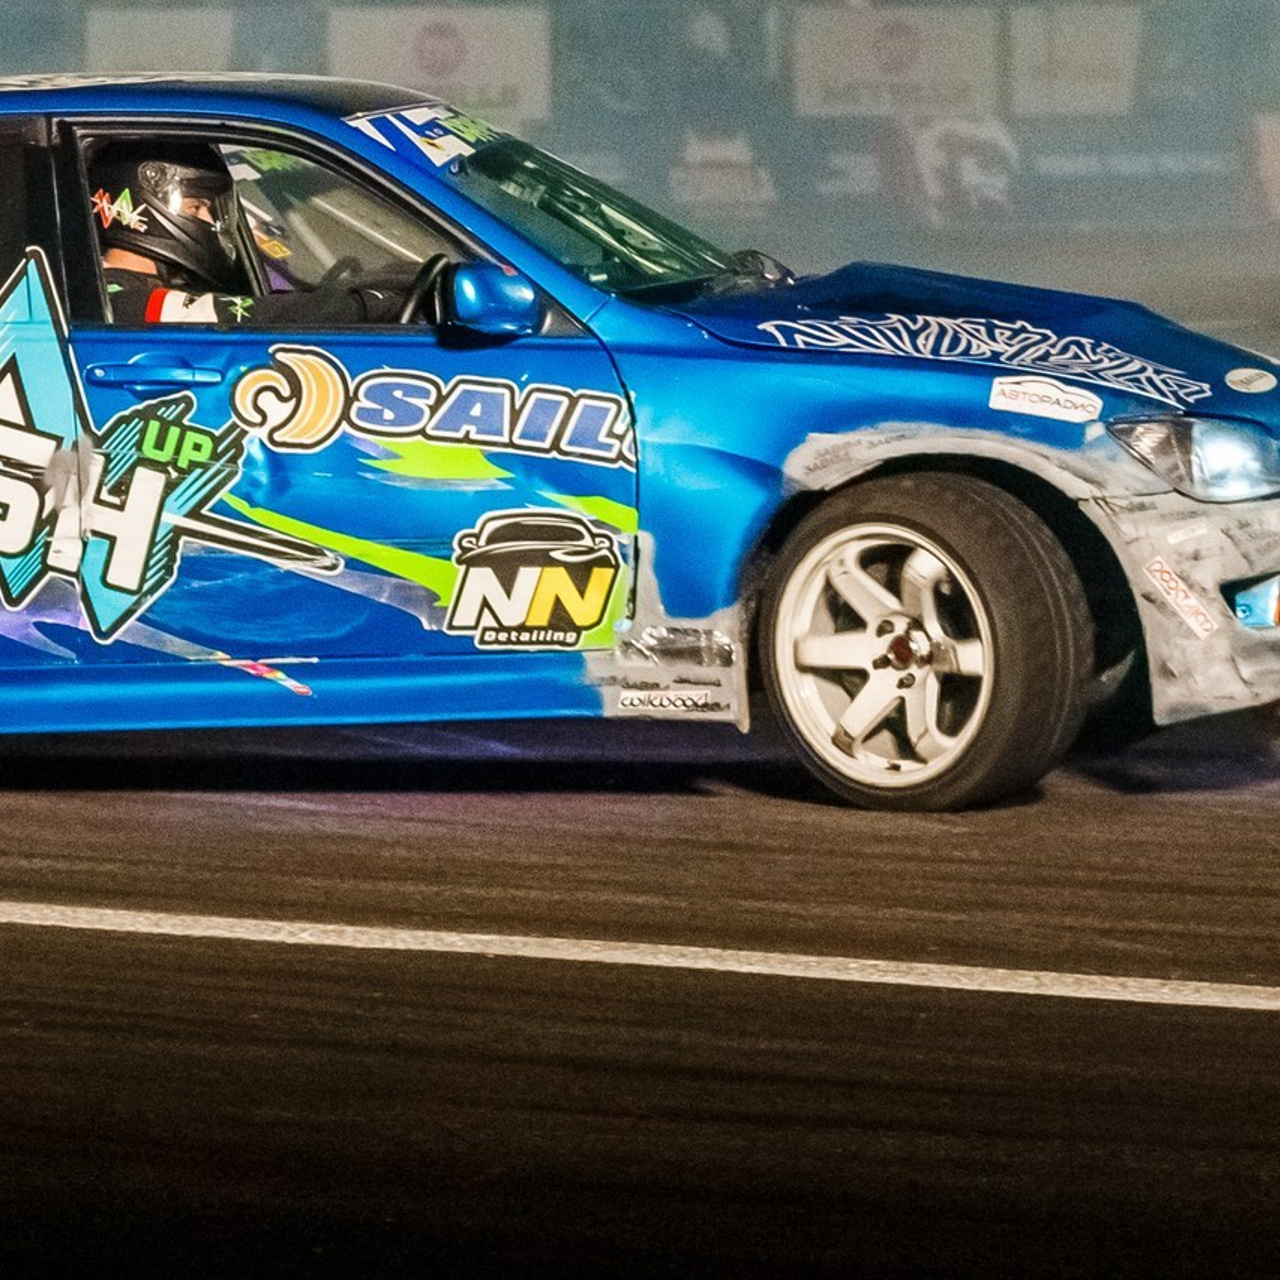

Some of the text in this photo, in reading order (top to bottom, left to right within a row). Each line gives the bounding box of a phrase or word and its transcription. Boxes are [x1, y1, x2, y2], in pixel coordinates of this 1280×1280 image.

[141, 419, 214, 469] UP
[354, 380, 636, 462] SAIL
[451, 566, 615, 627] NN
[483, 629, 578, 644] Detailing
